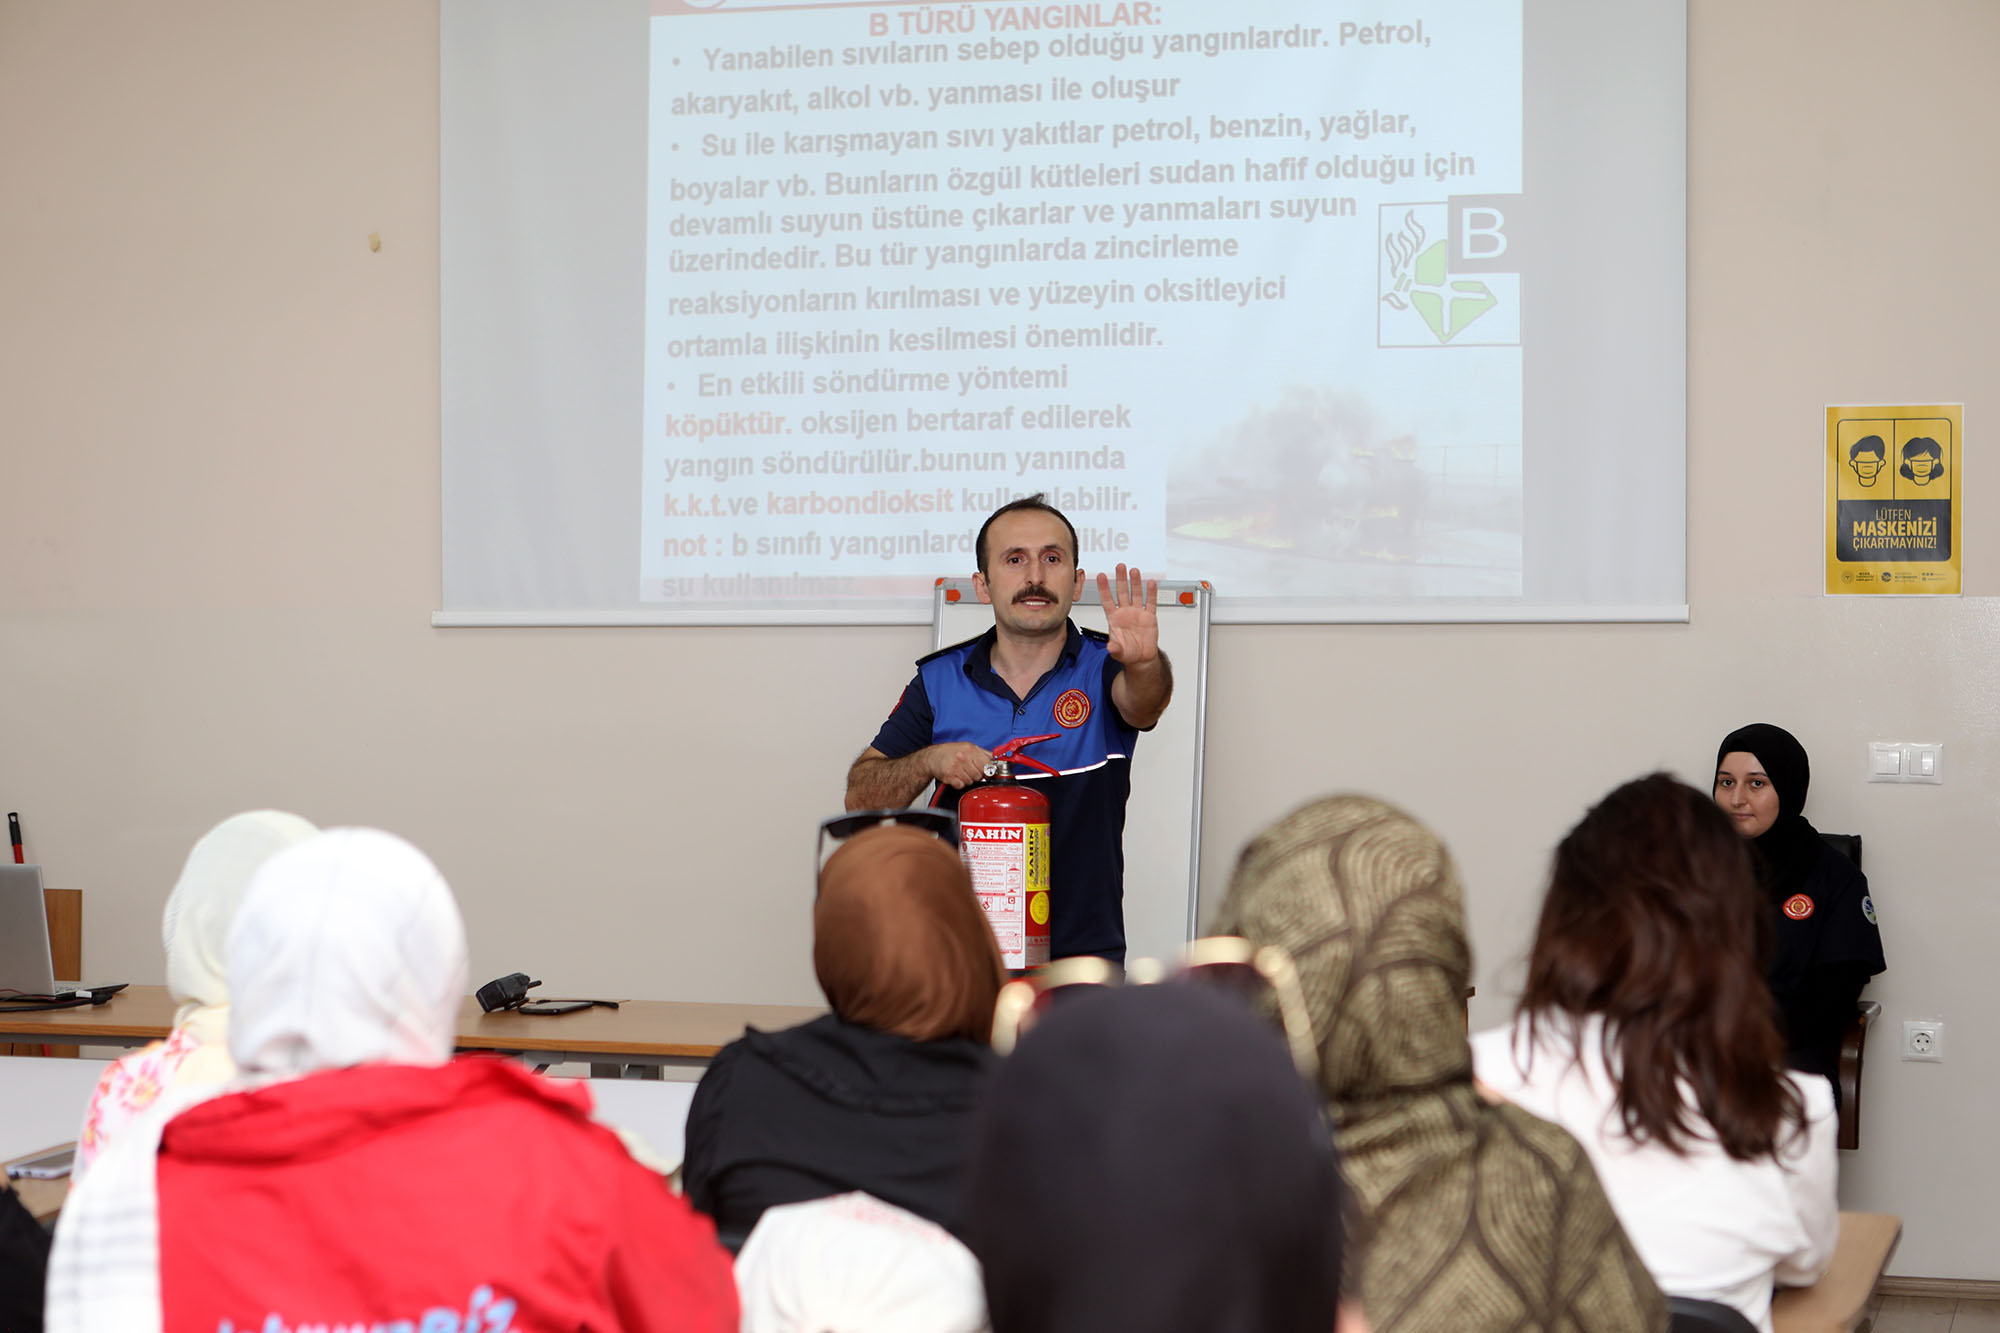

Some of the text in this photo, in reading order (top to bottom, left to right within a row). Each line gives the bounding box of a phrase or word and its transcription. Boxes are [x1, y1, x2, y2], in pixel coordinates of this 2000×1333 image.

[871, 3, 1162, 36] B TÜRÜ YANGINLAR:
[703, 19, 1432, 70] Yanabilen sıvıların sebep olduğu yangınlardır. Petrol,
[671, 75, 1180, 119] akaryakıt, alkol vb. yanması ile oluşur
[702, 109, 1417, 157] Su ile karışmayan sıvı yakıtlar petrol, benzin, yağlar,
[671, 152, 1474, 205] boyalar vb. Bunların özgül kütleleri sudan hafif olduğu için
[670, 196, 1355, 238] devamlı suyun üstüne çıkarlar ve yanmaları suyun
[1462, 208, 1507, 258] B
[670, 234, 1238, 272] üzerindedir. Bu tür yangınlarda zincirleme
[669, 275, 1284, 319] reaksiyonların kırılması ve yüzeyin oksitleyici
[668, 322, 1162, 360] ortamla ilişkinin kesilmesi önemlidir.
[699, 364, 1067, 397] En etkili söndürme yöntemi
[666, 404, 1130, 442] köpüktür. oksijen bertaraf edilerek
[665, 445, 1125, 482] yangın söndürülür.bunun yanında
[664, 493, 758, 518] k.k.t.ve
[768, 488, 953, 514] karbondioksit
[1875, 507, 1912, 521] LÜTFEN
[664, 535, 706, 556] not
[733, 532, 748, 556] b
[756, 530, 821, 555] sınıfı
[1852, 537, 1937, 551] ÇIKARTMAYINIZ!
[1853, 517, 1937, 537] MASKENİZİ
[662, 575, 693, 598] su
[966, 827, 1021, 841] ŞAHİN
